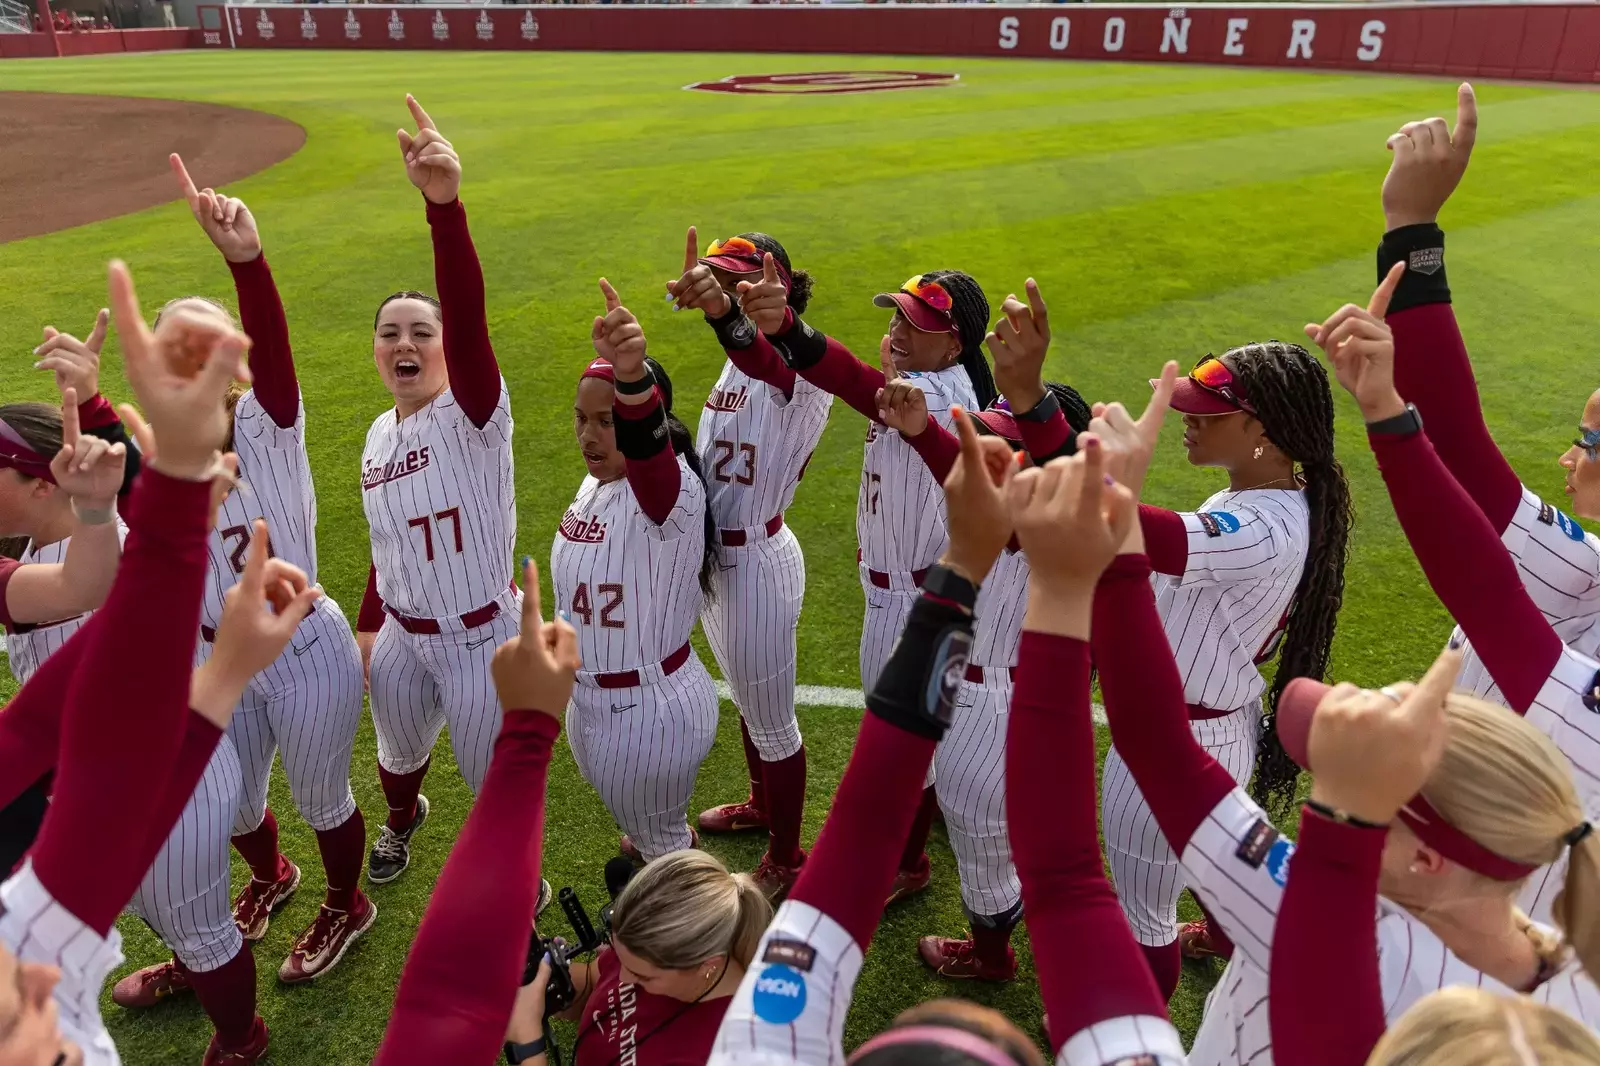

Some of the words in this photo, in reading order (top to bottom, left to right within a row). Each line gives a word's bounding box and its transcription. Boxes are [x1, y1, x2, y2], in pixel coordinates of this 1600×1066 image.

[999, 16, 1386, 62] SOONERS
[714, 440, 756, 486] 23
[408, 505, 464, 563] 77
[571, 582, 626, 629] 42
